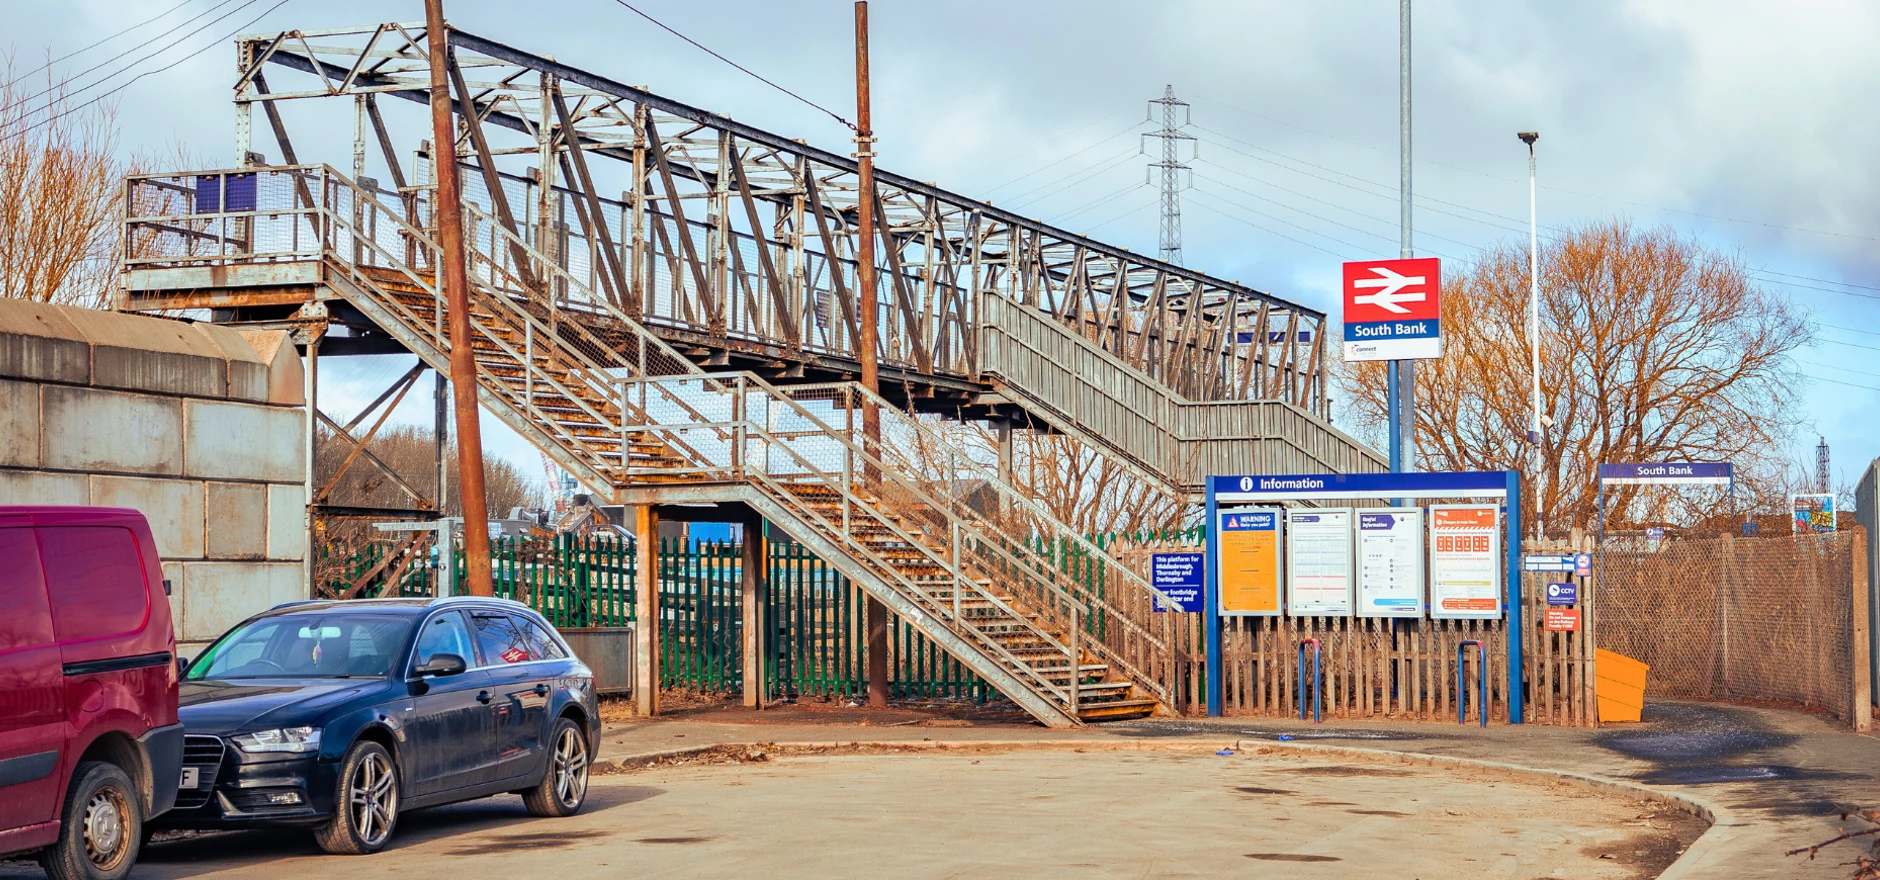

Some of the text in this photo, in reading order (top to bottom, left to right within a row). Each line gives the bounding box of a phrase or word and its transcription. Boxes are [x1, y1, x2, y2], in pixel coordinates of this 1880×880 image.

[1355, 322, 1427, 337] South Bank
[1637, 466, 1693, 475] South Bank
[1260, 478, 1324, 489] Information
[1240, 515, 1271, 523] WARNING
[1156, 576, 1184, 584] Darlington
[1170, 589, 1197, 597] footbridge
[182, 770, 191, 785] F
